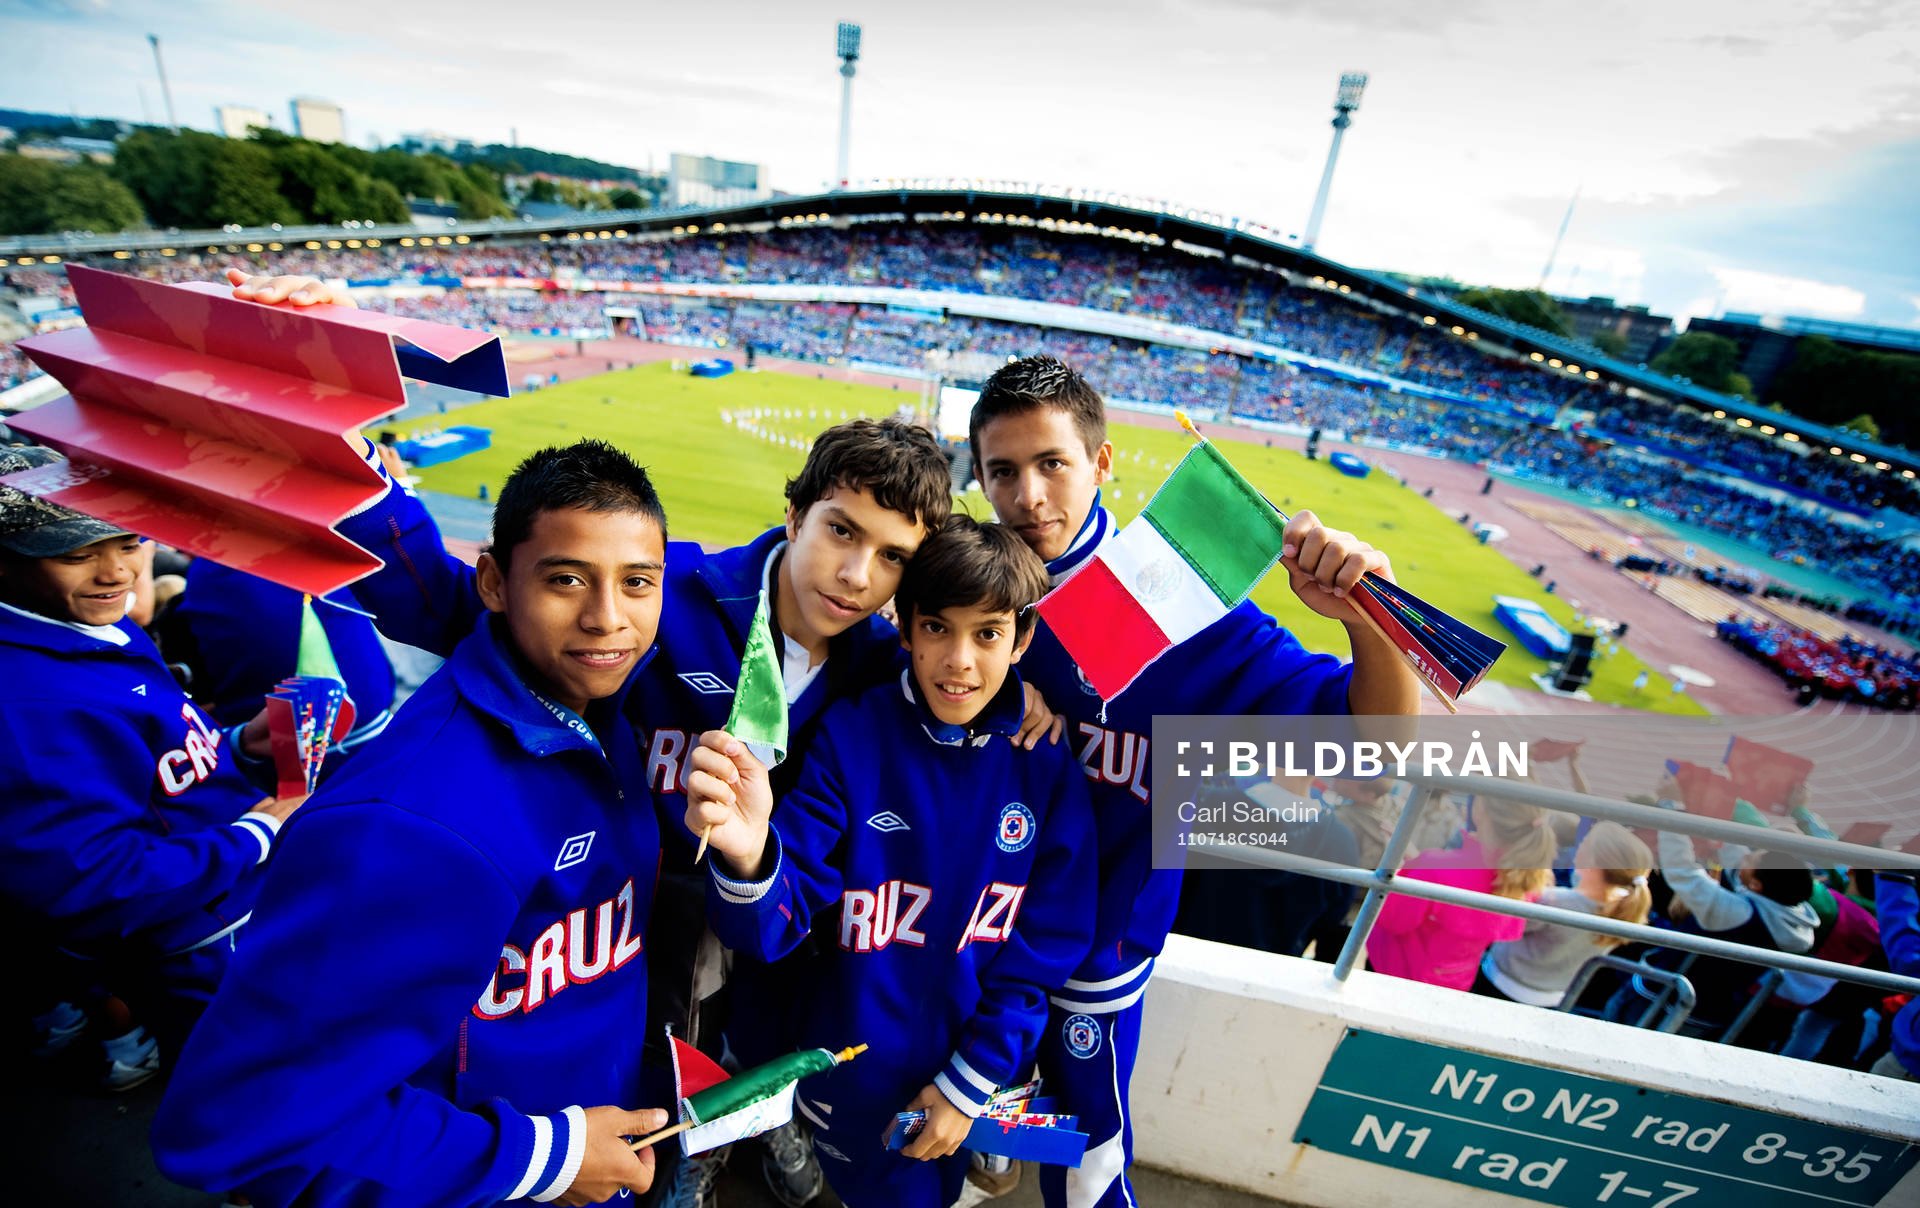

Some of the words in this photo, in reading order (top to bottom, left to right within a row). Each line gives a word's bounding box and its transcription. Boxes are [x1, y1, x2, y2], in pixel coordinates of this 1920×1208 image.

[567, 719, 593, 742] CUP
[1075, 720, 1150, 806] ZUL
[472, 876, 643, 1020] CRUZ
[839, 880, 932, 953] RUZ
[1350, 1113, 1432, 1160] N1
[1452, 1144, 1568, 1190] rad
[1595, 1169, 1700, 1208] 1-7
[1430, 1063, 1499, 1105] N1
[1501, 1087, 1536, 1113] o
[1541, 1087, 1620, 1132] N2
[1631, 1114, 1731, 1154] rad
[1742, 1132, 1883, 1184] 8-35
